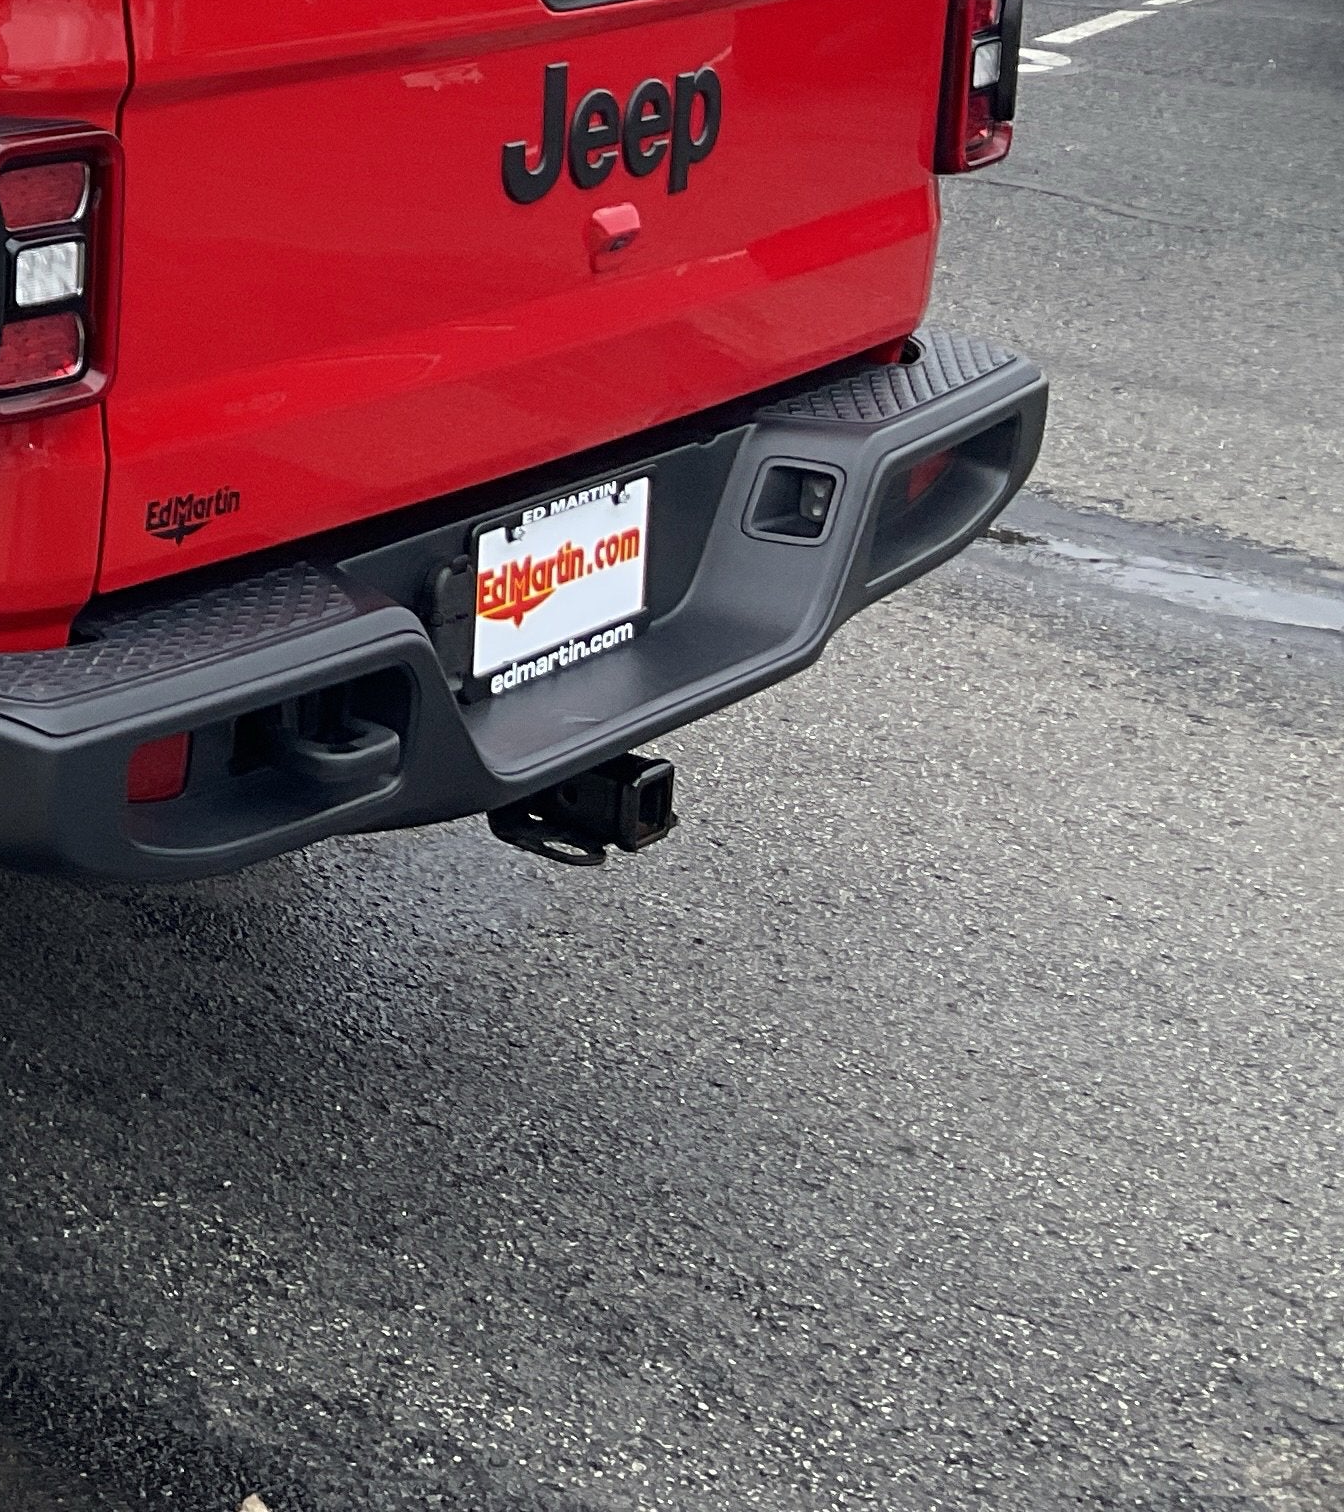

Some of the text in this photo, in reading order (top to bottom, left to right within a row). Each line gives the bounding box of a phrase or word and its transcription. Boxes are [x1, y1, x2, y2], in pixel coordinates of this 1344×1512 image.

[501, 62, 722, 205] Jeep
[522, 481, 617, 525] ED MARTIN
[490, 622, 634, 694] edmartin.com
